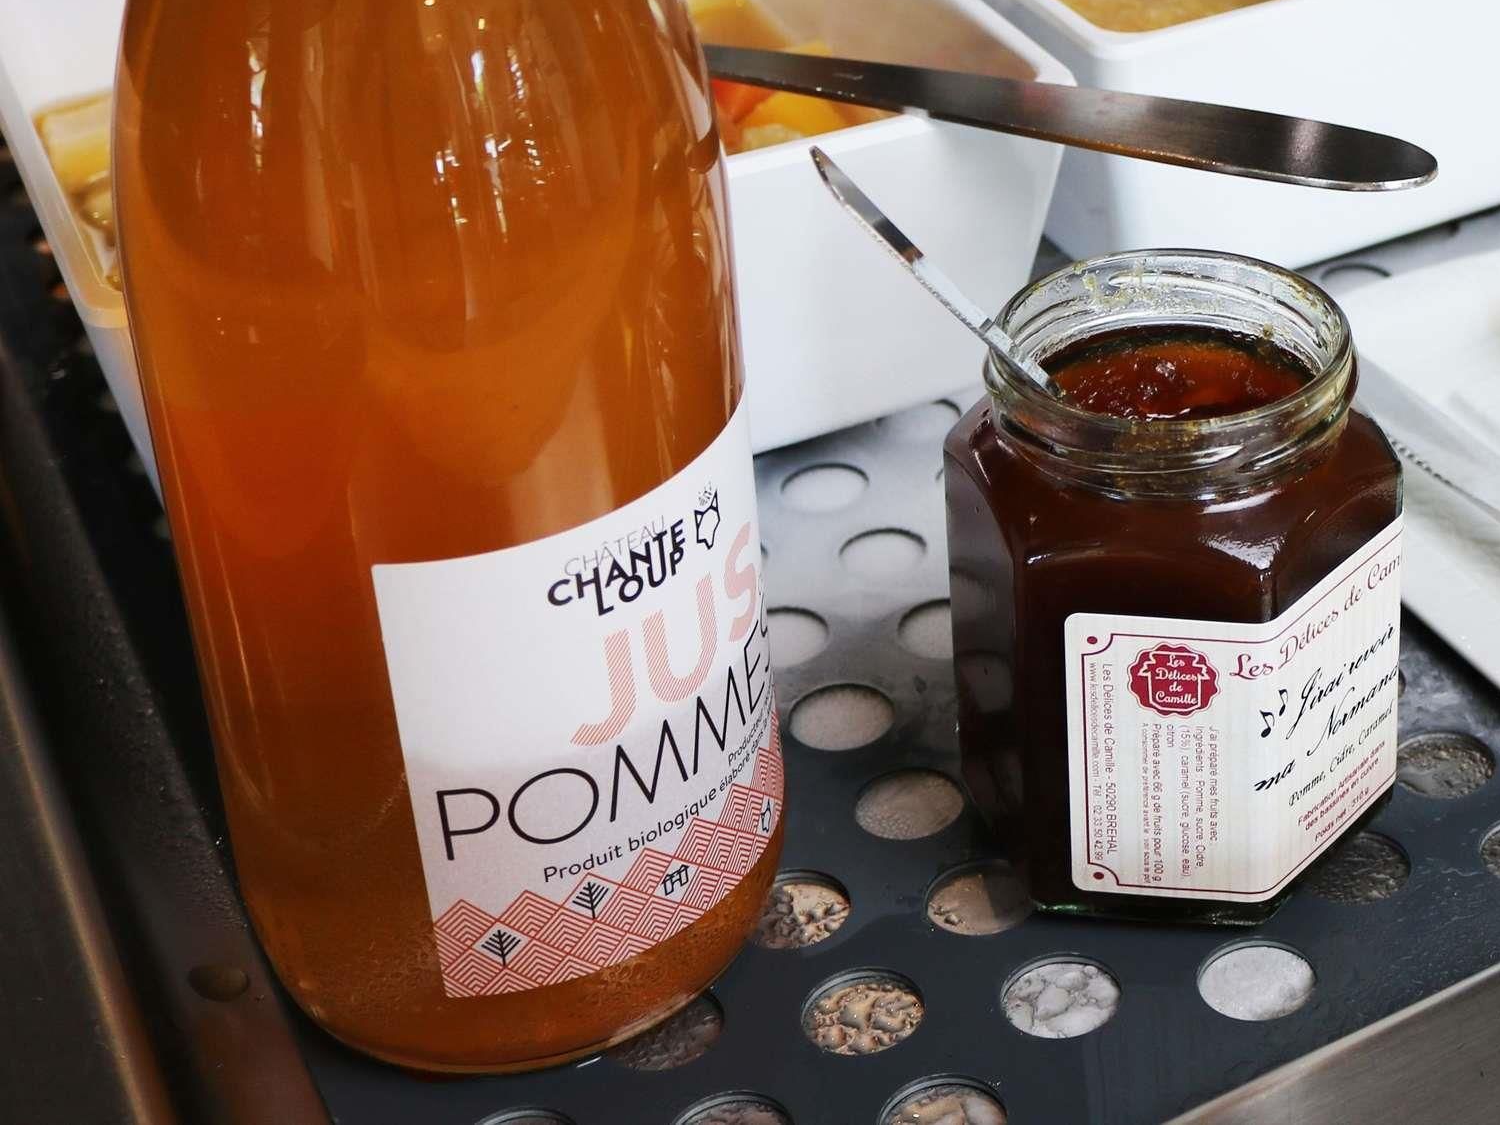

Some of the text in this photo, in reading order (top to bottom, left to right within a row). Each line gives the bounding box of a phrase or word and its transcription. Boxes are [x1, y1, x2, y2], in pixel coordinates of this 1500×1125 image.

[547, 519, 686, 606] CHANTE
[595, 546, 686, 617] LOUP
[570, 521, 758, 748] JUS
[1229, 653, 1274, 681] Les
[1278, 610, 1339, 670] Délices
[1344, 584, 1362, 611] de
[1349, 623, 1395, 675] revoir
[1102, 663, 1113, 682] Les
[1155, 667, 1197, 681] Délices
[1166, 654, 1186, 668] Les
[1155, 691, 1198, 705] Camille
[1168, 681, 1184, 692] de
[1104, 737, 1116, 773] Camille
[1254, 759, 1296, 792] ma
[543, 844, 624, 883] Produit
[628, 786, 718, 853] biologique
